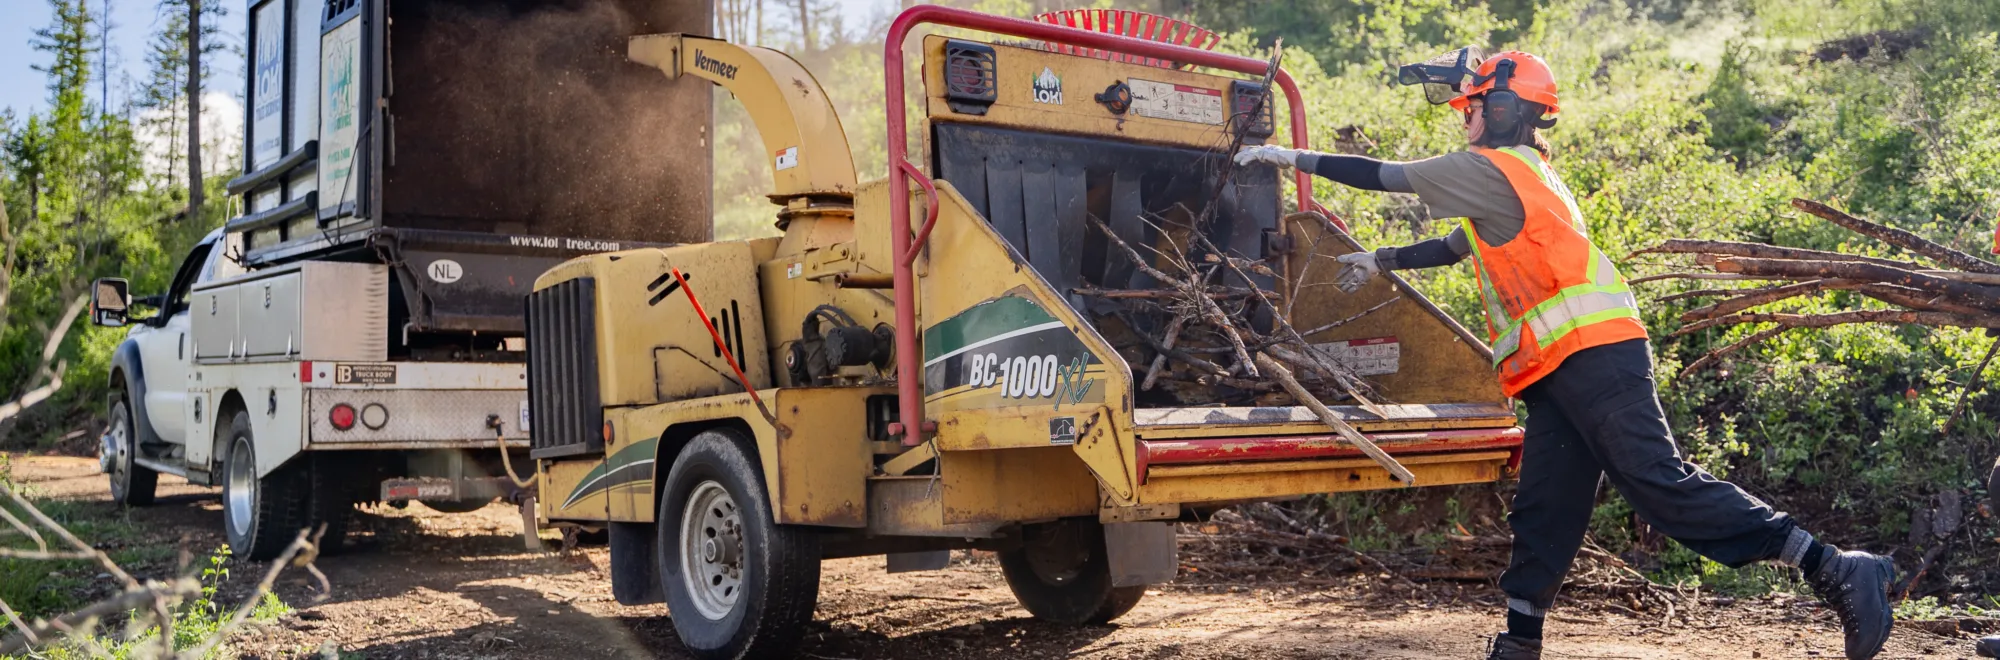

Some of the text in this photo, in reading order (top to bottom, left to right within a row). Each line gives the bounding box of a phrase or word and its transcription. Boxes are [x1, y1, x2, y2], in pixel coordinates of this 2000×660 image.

[695, 48, 738, 80] Vermeer
[1033, 88, 1063, 105] LOKI
[434, 264, 456, 279] NL
[970, 352, 1094, 411] BC 1000 XL
